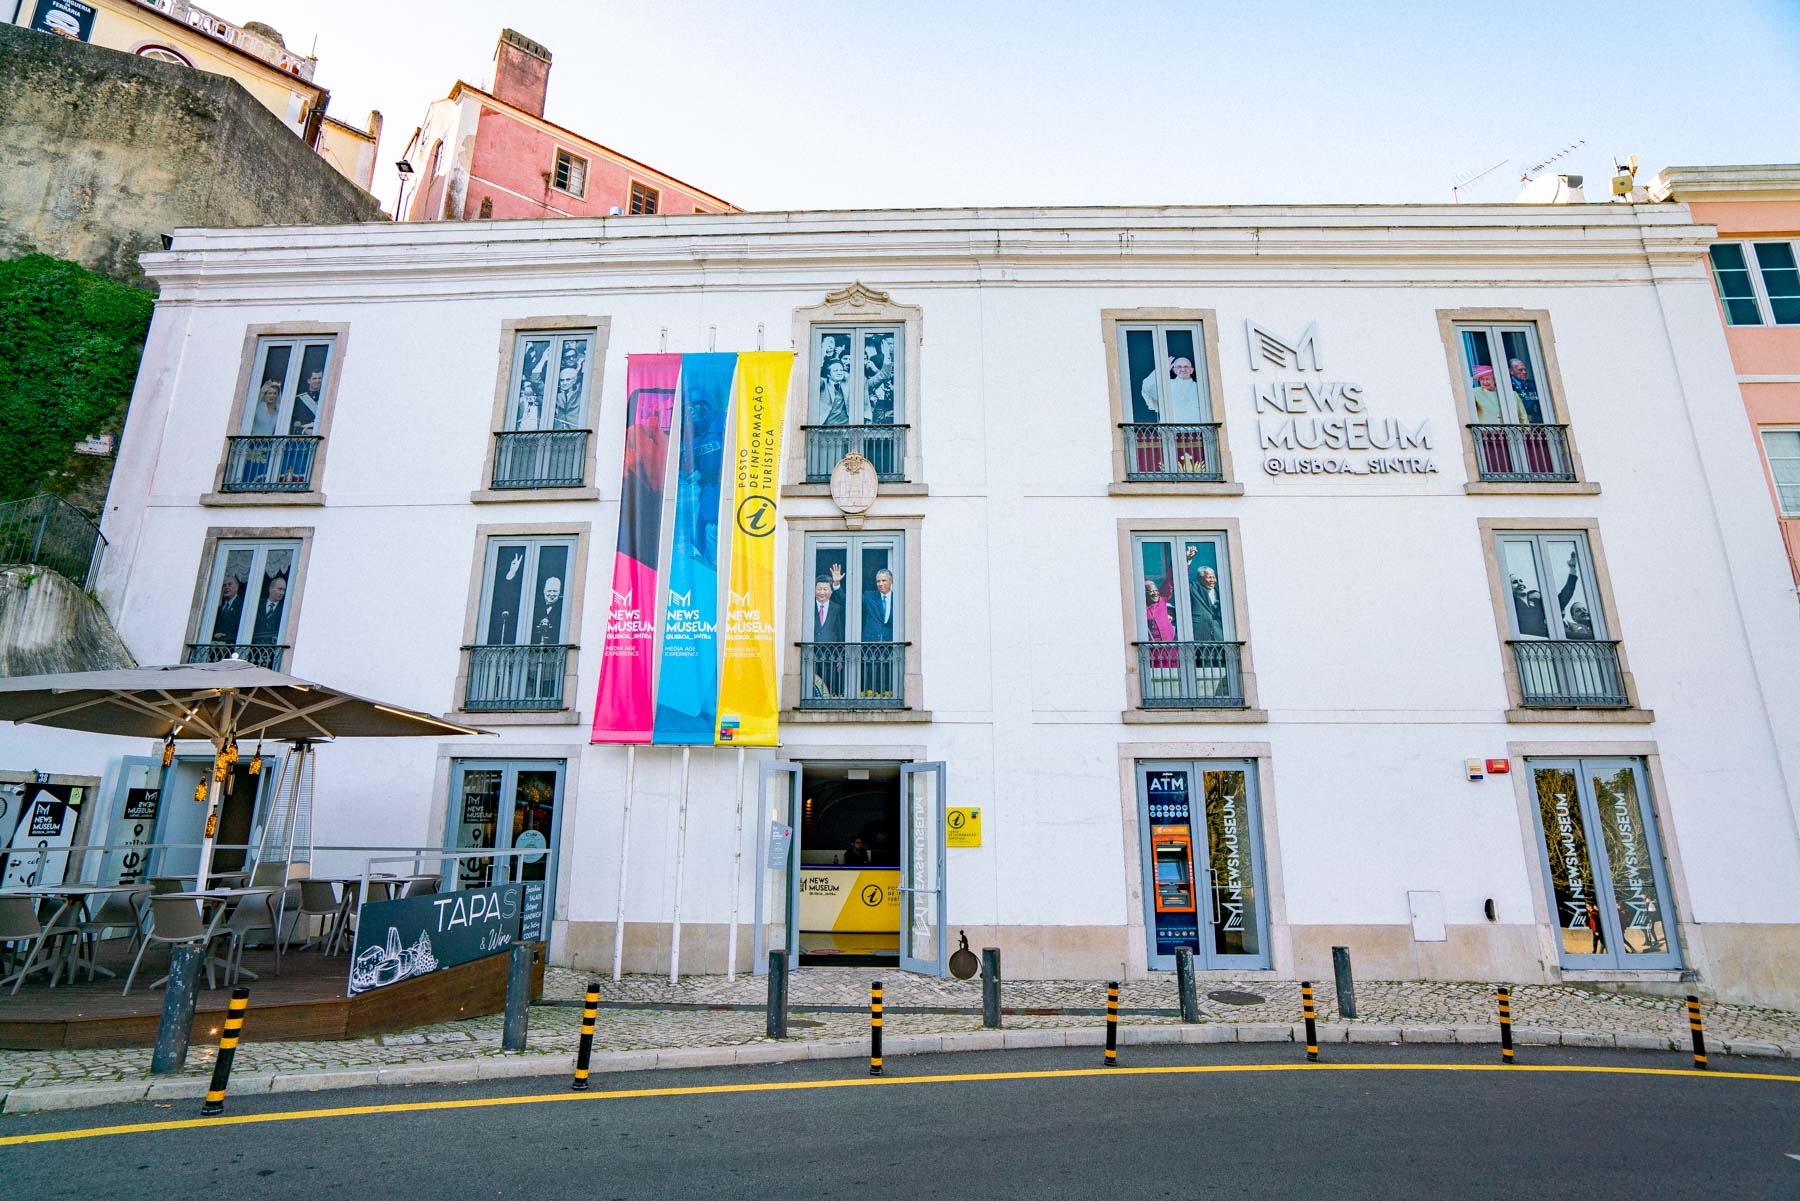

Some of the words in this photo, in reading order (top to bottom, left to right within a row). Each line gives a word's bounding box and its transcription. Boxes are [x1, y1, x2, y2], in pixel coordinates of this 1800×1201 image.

[1253, 381, 1364, 414] NEWS
[752, 385, 764, 469] INFORMAÇÃO
[1258, 416, 1433, 450] MUSEUM
[738, 448, 748, 489] POSTO
[762, 429, 774, 489] TURÍSTICA
[1263, 456, 1440, 476] @LISBOA_SINTRA
[750, 472, 759, 488] DE
[608, 609, 641, 620] NEWS
[666, 621, 718, 632] MUSEUM
[667, 609, 700, 620] NEWS
[727, 609, 760, 621] NEWS
[1150, 777, 1184, 791] ATM
[1222, 795, 1243, 900] NEWSMUSEUM
[1554, 793, 1586, 899] NEWSMUSEUM
[1613, 792, 1643, 899] NEWSMUSEUM
[433, 888, 518, 933] TAPAS
[488, 923, 512, 951] Wine
